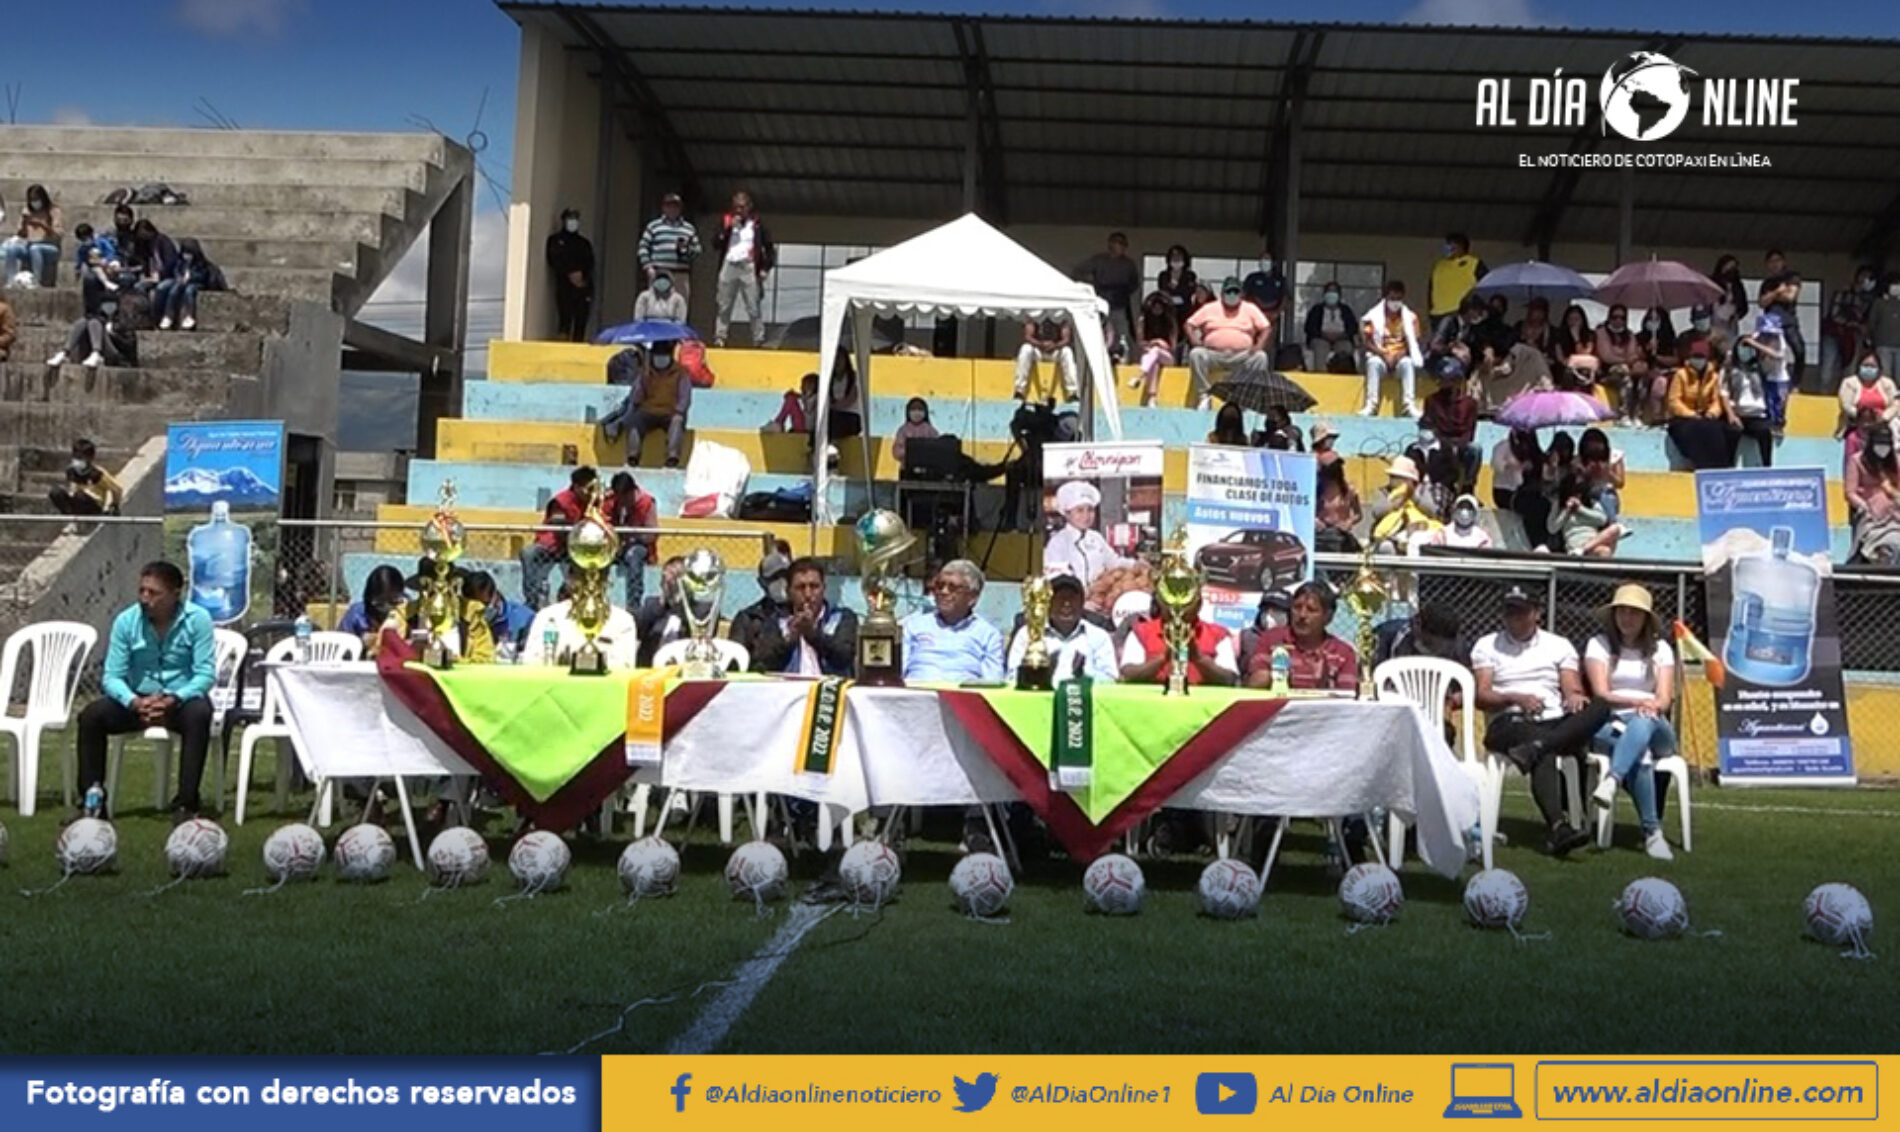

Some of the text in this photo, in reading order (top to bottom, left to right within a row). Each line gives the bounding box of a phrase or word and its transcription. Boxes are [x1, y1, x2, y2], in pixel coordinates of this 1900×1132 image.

[1197, 472, 1298, 492] FINANCIAMOS TODA
[1225, 488, 1310, 507] CLASE DE AUTOS
[1194, 505, 1227, 520] Autos
[811, 726, 831, 756] 2022
[1067, 719, 1084, 749] 2022
